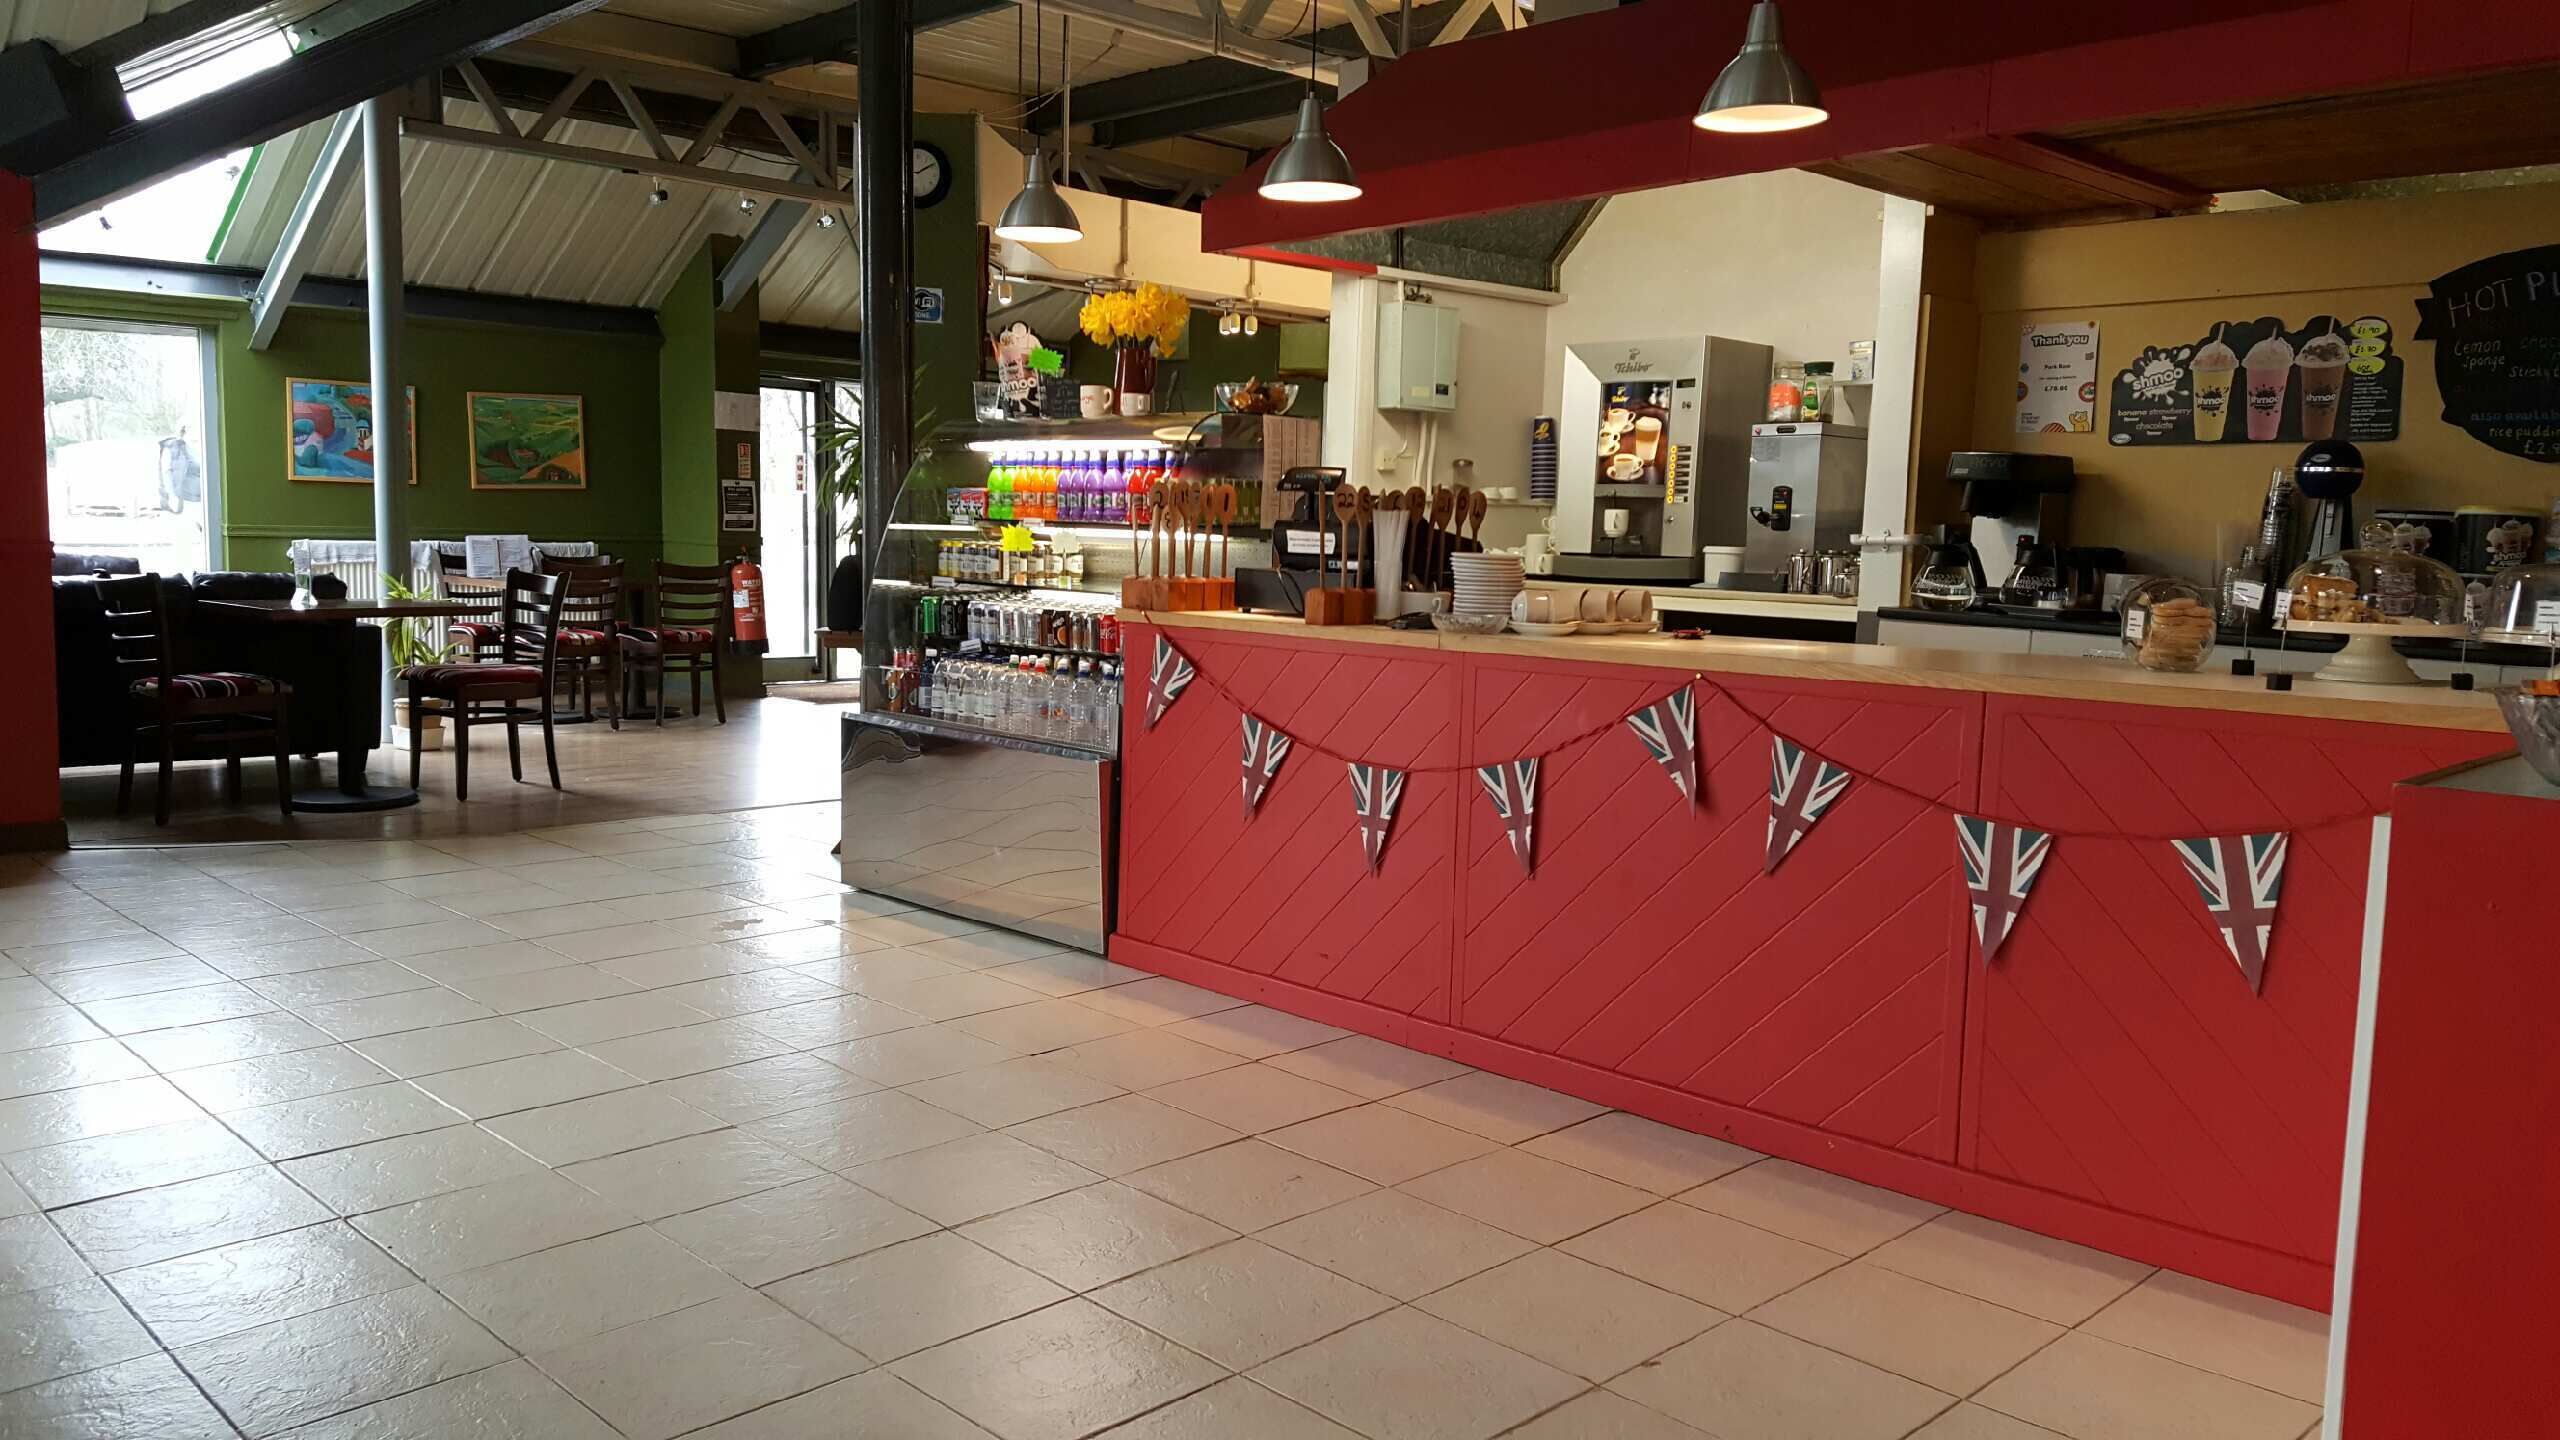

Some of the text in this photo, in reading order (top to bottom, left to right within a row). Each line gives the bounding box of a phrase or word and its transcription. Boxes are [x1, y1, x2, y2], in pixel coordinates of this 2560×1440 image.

[2447, 277, 2513, 329] HOT
[2064, 334, 2090, 347] you
[2454, 336, 2502, 357] Lemon
[1614, 362, 1654, 374] Tchibo
[2131, 366, 2185, 391] shmoo
[1337, 492, 1355, 508] 22
